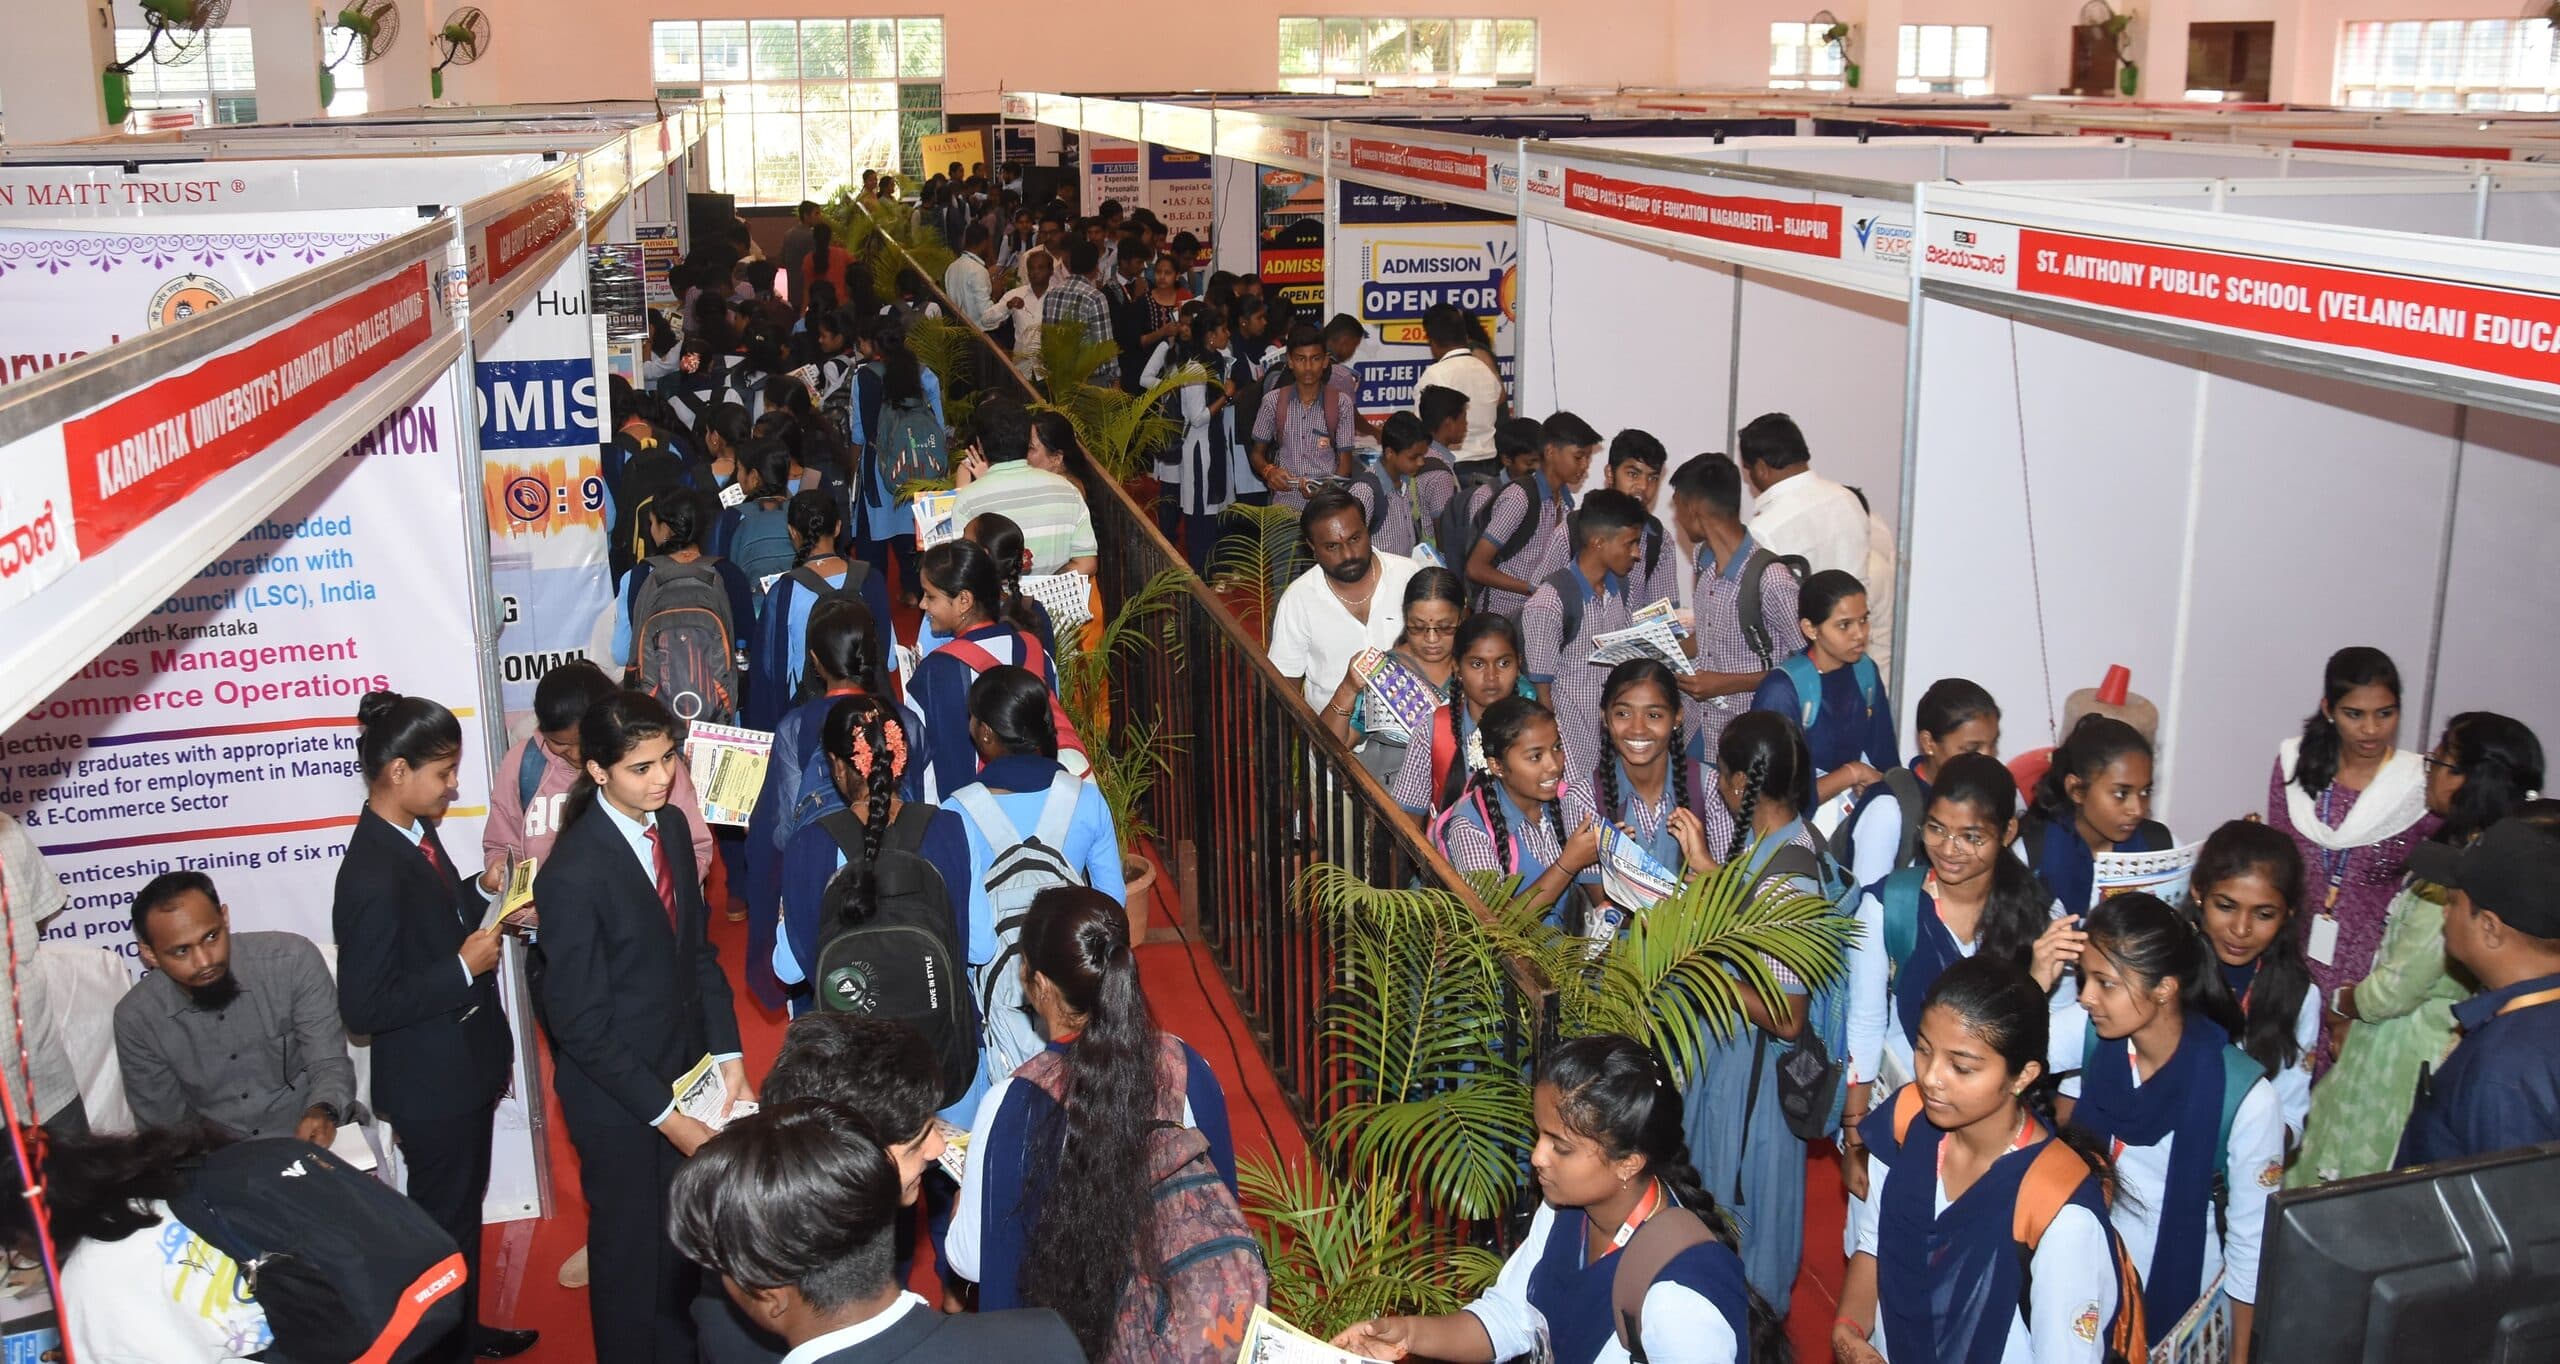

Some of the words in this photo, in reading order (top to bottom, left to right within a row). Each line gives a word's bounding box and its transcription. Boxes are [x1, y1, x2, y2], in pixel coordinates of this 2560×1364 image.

[1408, 156, 1432, 169] COMMERCE
[1434, 159, 1454, 174] COLLEGE
[1454, 162, 1480, 178] DHARWAD
[27, 183, 111, 205] MATT
[120, 181, 221, 204] TRUST
[1169, 184, 1199, 193] Special
[1169, 198, 1186, 206] IAS
[1572, 181, 1599, 202] OXFORD
[1625, 192, 1650, 213] GROUP
[1652, 198, 1662, 215] OF
[1663, 200, 1708, 222] EDUCATION
[1710, 208, 1773, 232] NAGARABETTA
[1784, 218, 1829, 241] BIJAPUR
[1382, 257, 1481, 274] ADMISSION
[1282, 290, 1310, 300] OPEN
[1366, 290, 1438, 312] OPEN
[1447, 287, 1498, 310] FOR
[2037, 250, 2060, 275] ST.
[2064, 256, 2146, 287] ANTHONY
[2150, 266, 2220, 300] PUBLIC
[2226, 278, 2312, 315] SCHOOL
[2319, 289, 2467, 339] (VELANGANI
[1365, 366, 1413, 382] IIT-JEE
[96, 414, 192, 500] KARNATAK
[190, 368, 280, 449] UNIVERSITY'S
[281, 340, 332, 401] KARNATAK
[333, 327, 356, 370] ARTS
[356, 307, 390, 352] COLLEGE
[476, 376, 600, 432] MIS
[1362, 390, 1374, 402] &
[343, 406, 438, 458] ATION
[238, 516, 352, 542] mbedded
[193, 552, 299, 579] boration
[306, 548, 353, 571] with
[244, 584, 314, 613] (LSC),
[321, 580, 376, 604] India
[69, 655, 140, 682] tics
[151, 635, 359, 675] Management
[214, 671, 392, 709] Operations
[18, 756, 72, 783] ready
[78, 748, 171, 777] graduates
[175, 744, 218, 765] with
[222, 733, 330, 764] appropriate
[28, 779, 109, 807] required
[114, 773, 144, 796] for
[147, 766, 266, 797] employment
[270, 763, 286, 781] in
[291, 760, 364, 779] Manage
[26, 809, 42, 827] &
[47, 798, 166, 826] E-Commerce
[171, 791, 229, 815] Sector
[57, 858, 171, 888] enticeship
[175, 847, 262, 877] Training
[266, 845, 288, 864] of
[293, 841, 323, 862] six
[62, 889, 138, 912] Compa
[924, 955, 935, 979] STYLE
[929, 988, 938, 1010] MOVE
